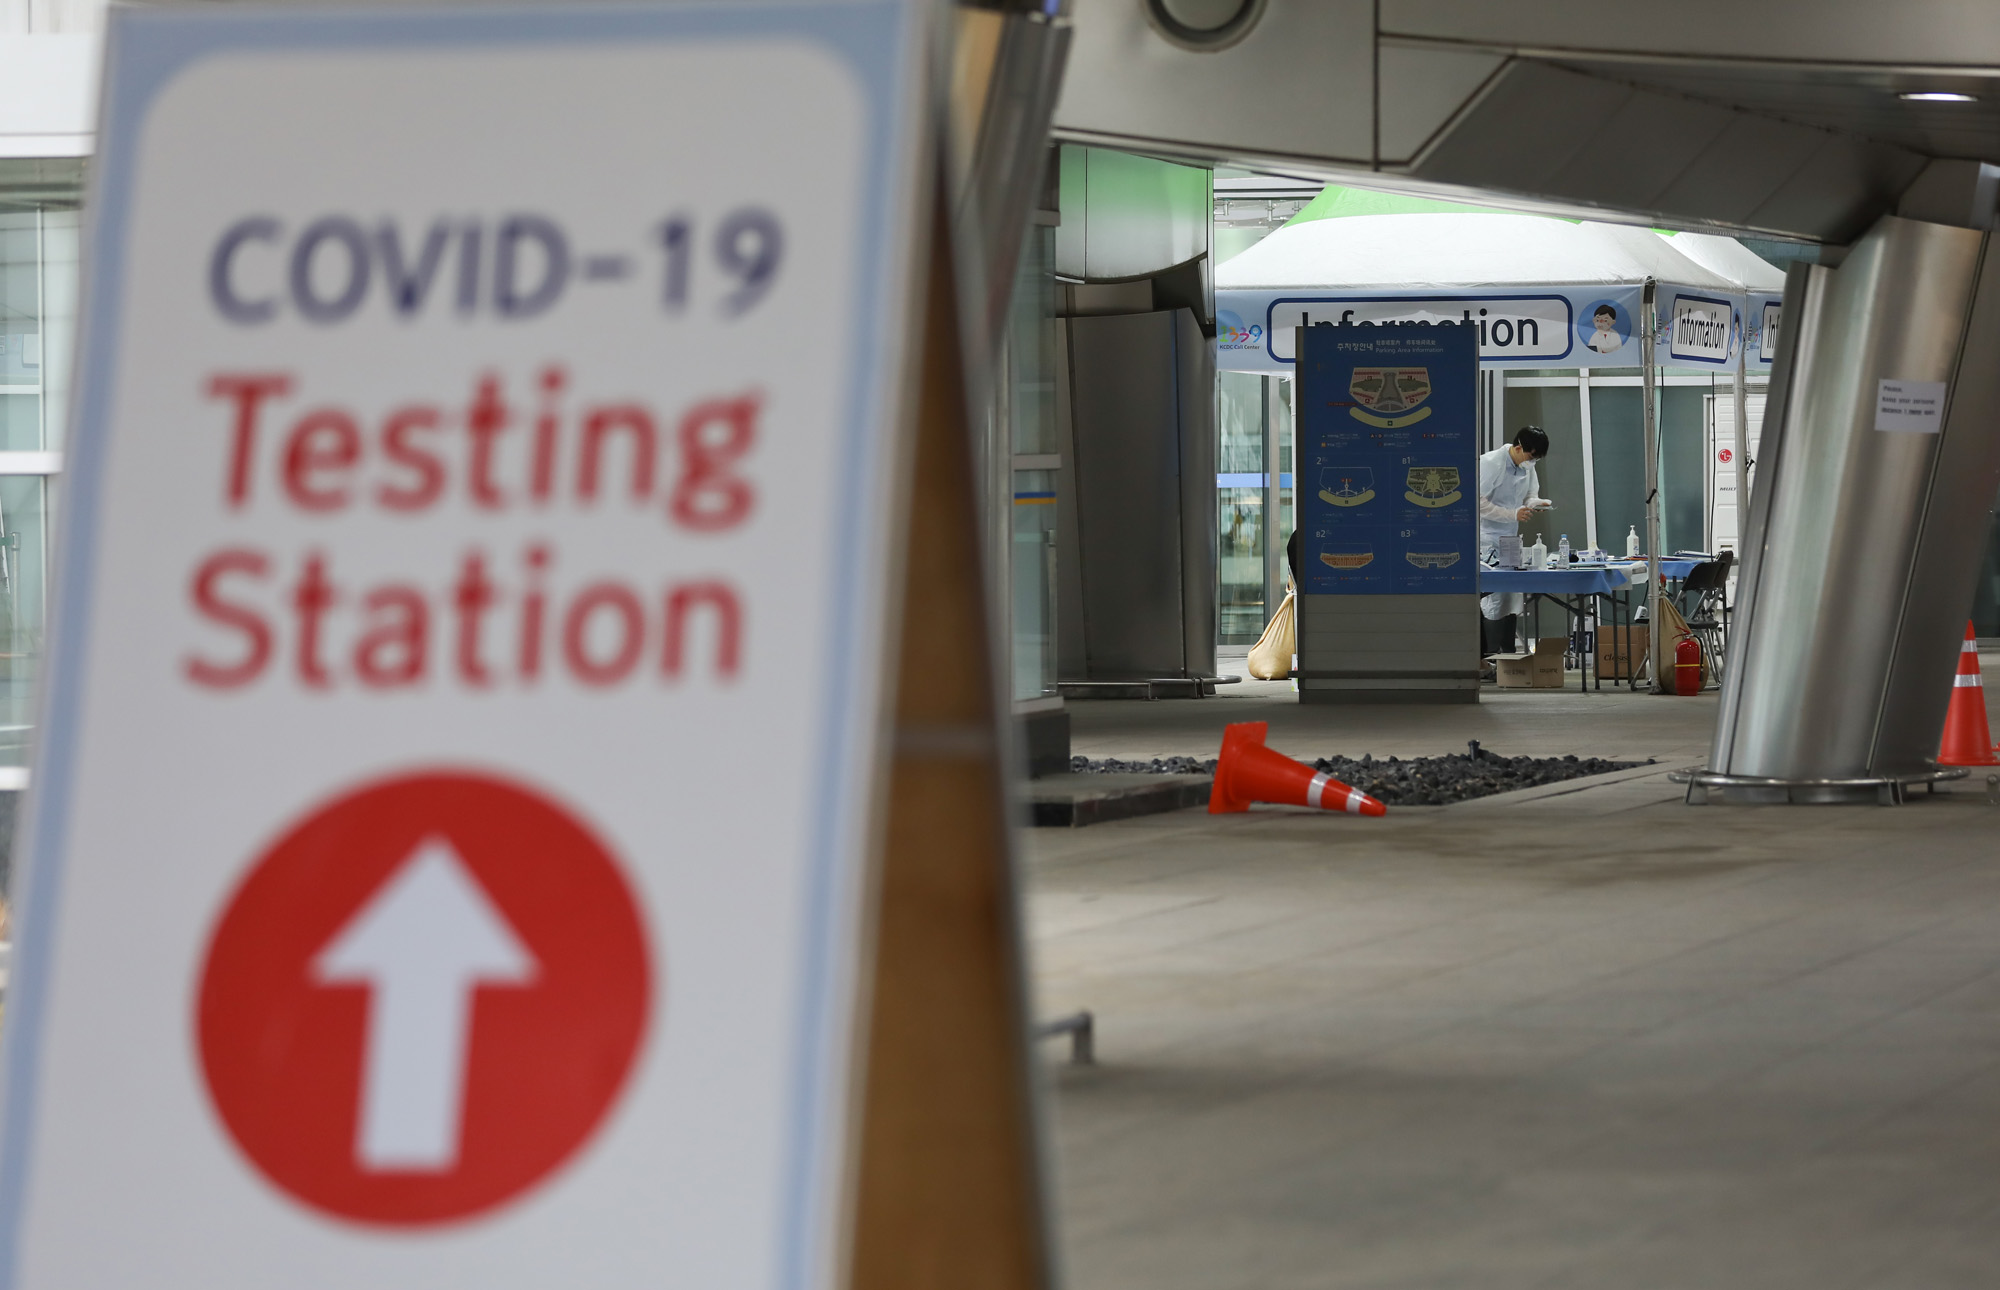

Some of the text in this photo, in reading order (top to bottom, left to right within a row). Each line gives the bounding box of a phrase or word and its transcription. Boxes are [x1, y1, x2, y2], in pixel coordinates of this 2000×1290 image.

[209, 206, 785, 325] COVID-19
[1219, 324, 1263, 343] 1339
[1677, 308, 1725, 349] Information
[1336, 342, 1374, 352] 주차장안내
[1375, 347, 1396, 355] Parking
[205, 366, 763, 532] Testing
[1315, 529, 1326, 538] B2
[1400, 529, 1411, 538] B3
[185, 543, 743, 690] Station
